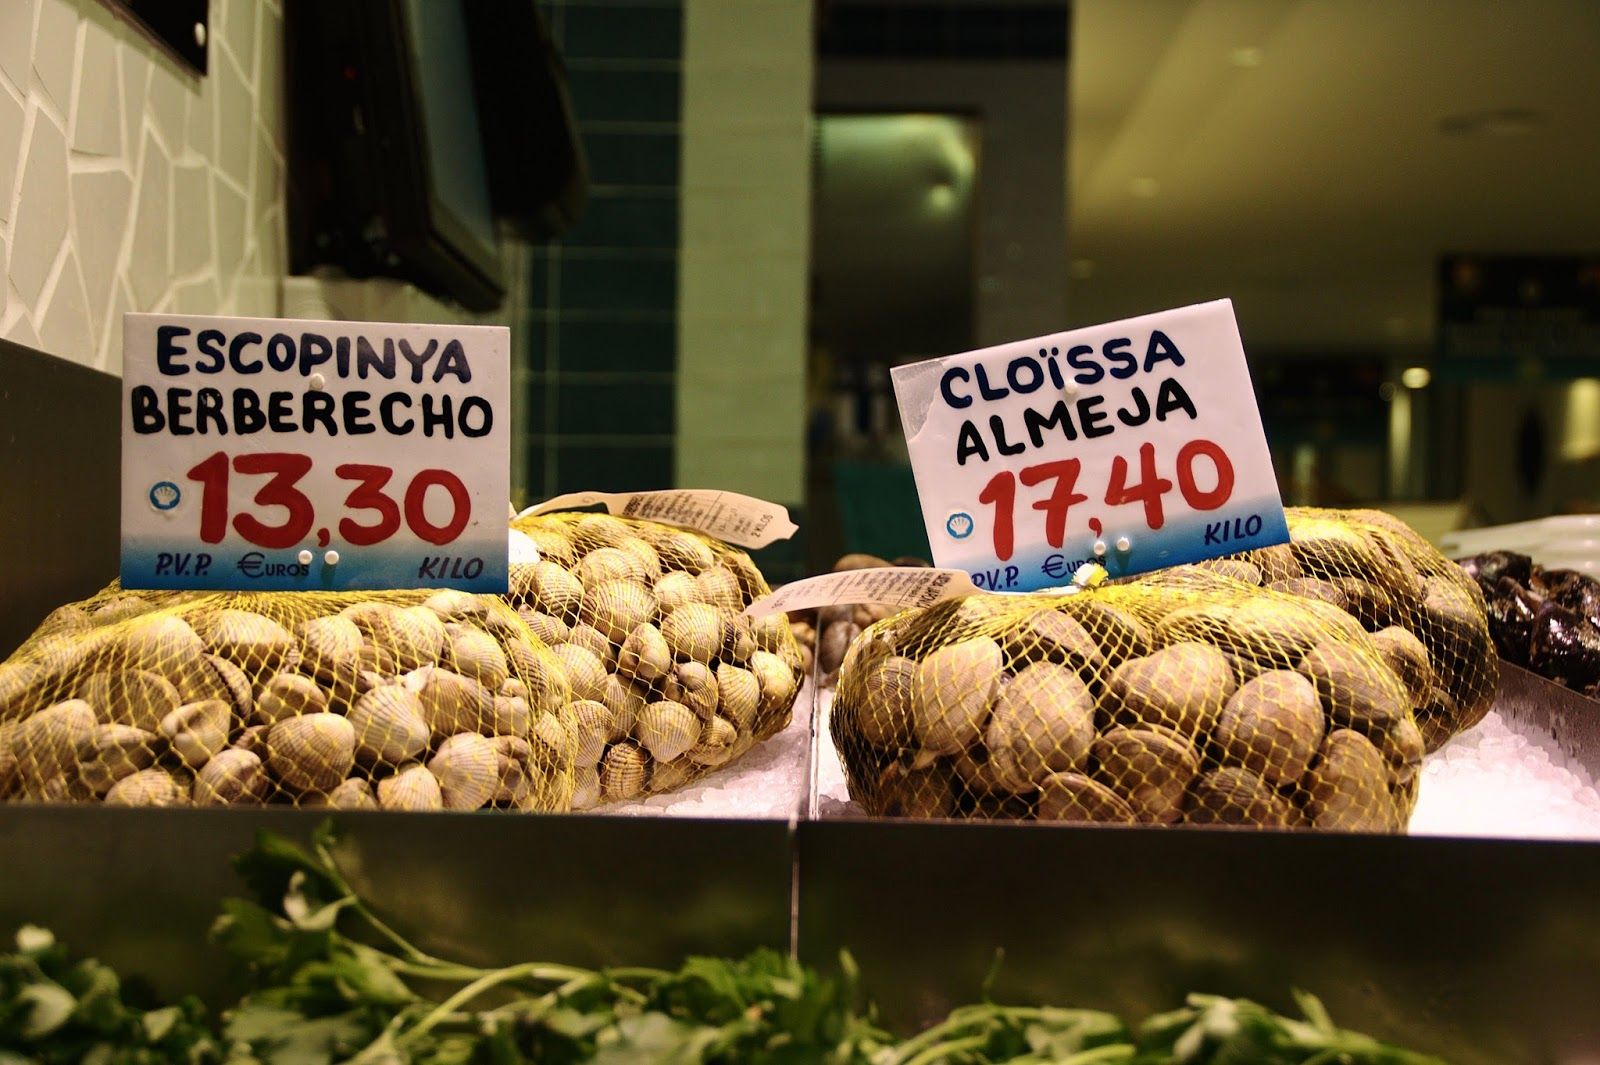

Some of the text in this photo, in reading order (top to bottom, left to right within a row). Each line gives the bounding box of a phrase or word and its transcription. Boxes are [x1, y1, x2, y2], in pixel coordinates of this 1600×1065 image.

[156, 325, 473, 384] ESCOPINYA
[940, 330, 1186, 410] CLOÏSSA
[131, 384, 494, 440] BERBERECHO
[956, 377, 1198, 466] ALMEJA
[186, 451, 472, 549] 13,30
[978, 439, 1235, 562] 17,40
[155, 552, 213, 577] P.V.P.
[418, 556, 484, 580] KILO
[971, 565, 1019, 592] PV.P.
[1204, 514, 1263, 547] KILO
